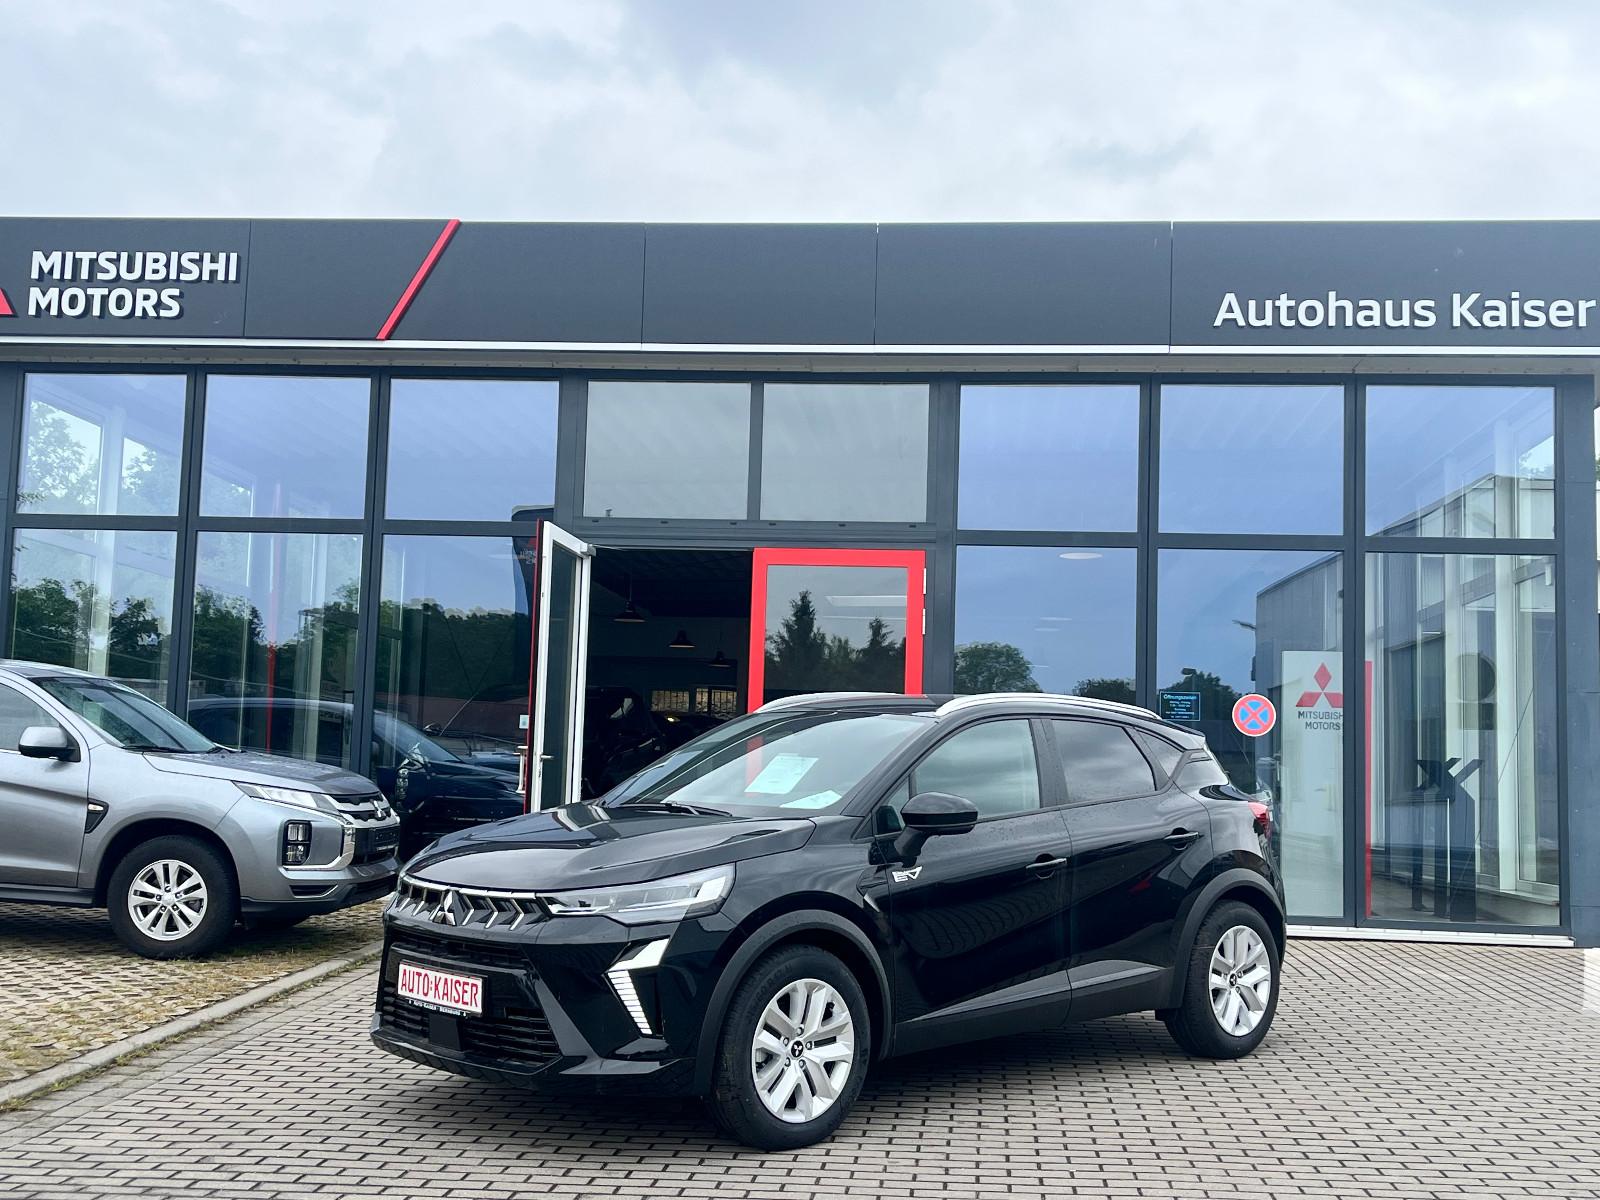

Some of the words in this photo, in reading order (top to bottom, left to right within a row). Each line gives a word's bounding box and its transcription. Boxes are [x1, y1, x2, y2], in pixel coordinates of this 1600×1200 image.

[30, 250, 239, 281] MITSUBISHI
[27, 286, 181, 318] MOTORS
[1212, 290, 1437, 328] Autohaus
[1451, 291, 1598, 329] Kaiser
[1297, 710, 1344, 720] MITSUBISH
[1304, 721, 1341, 730] MOTORS
